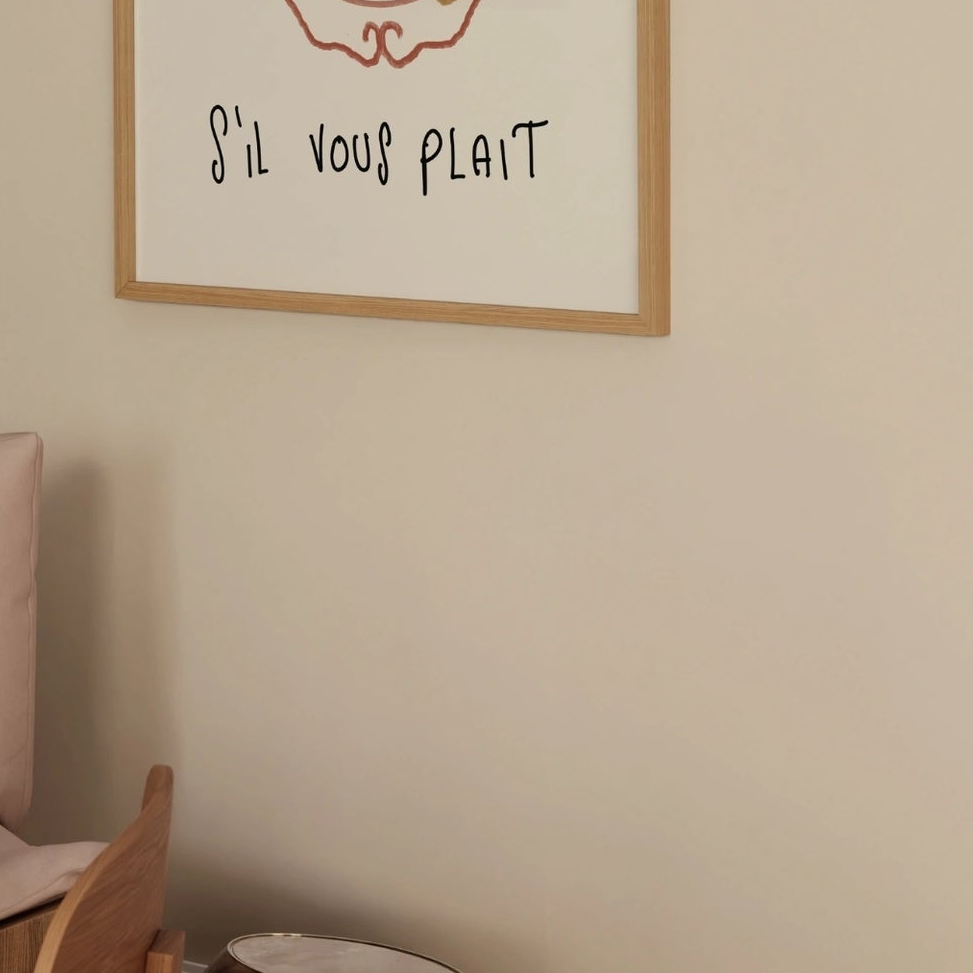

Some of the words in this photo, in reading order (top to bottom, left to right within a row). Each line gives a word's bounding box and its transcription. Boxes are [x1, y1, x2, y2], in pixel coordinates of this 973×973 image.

[209, 104, 269, 185] S'IL
[308, 121, 392, 186] VOUS
[419, 119, 549, 197] PLAIT
